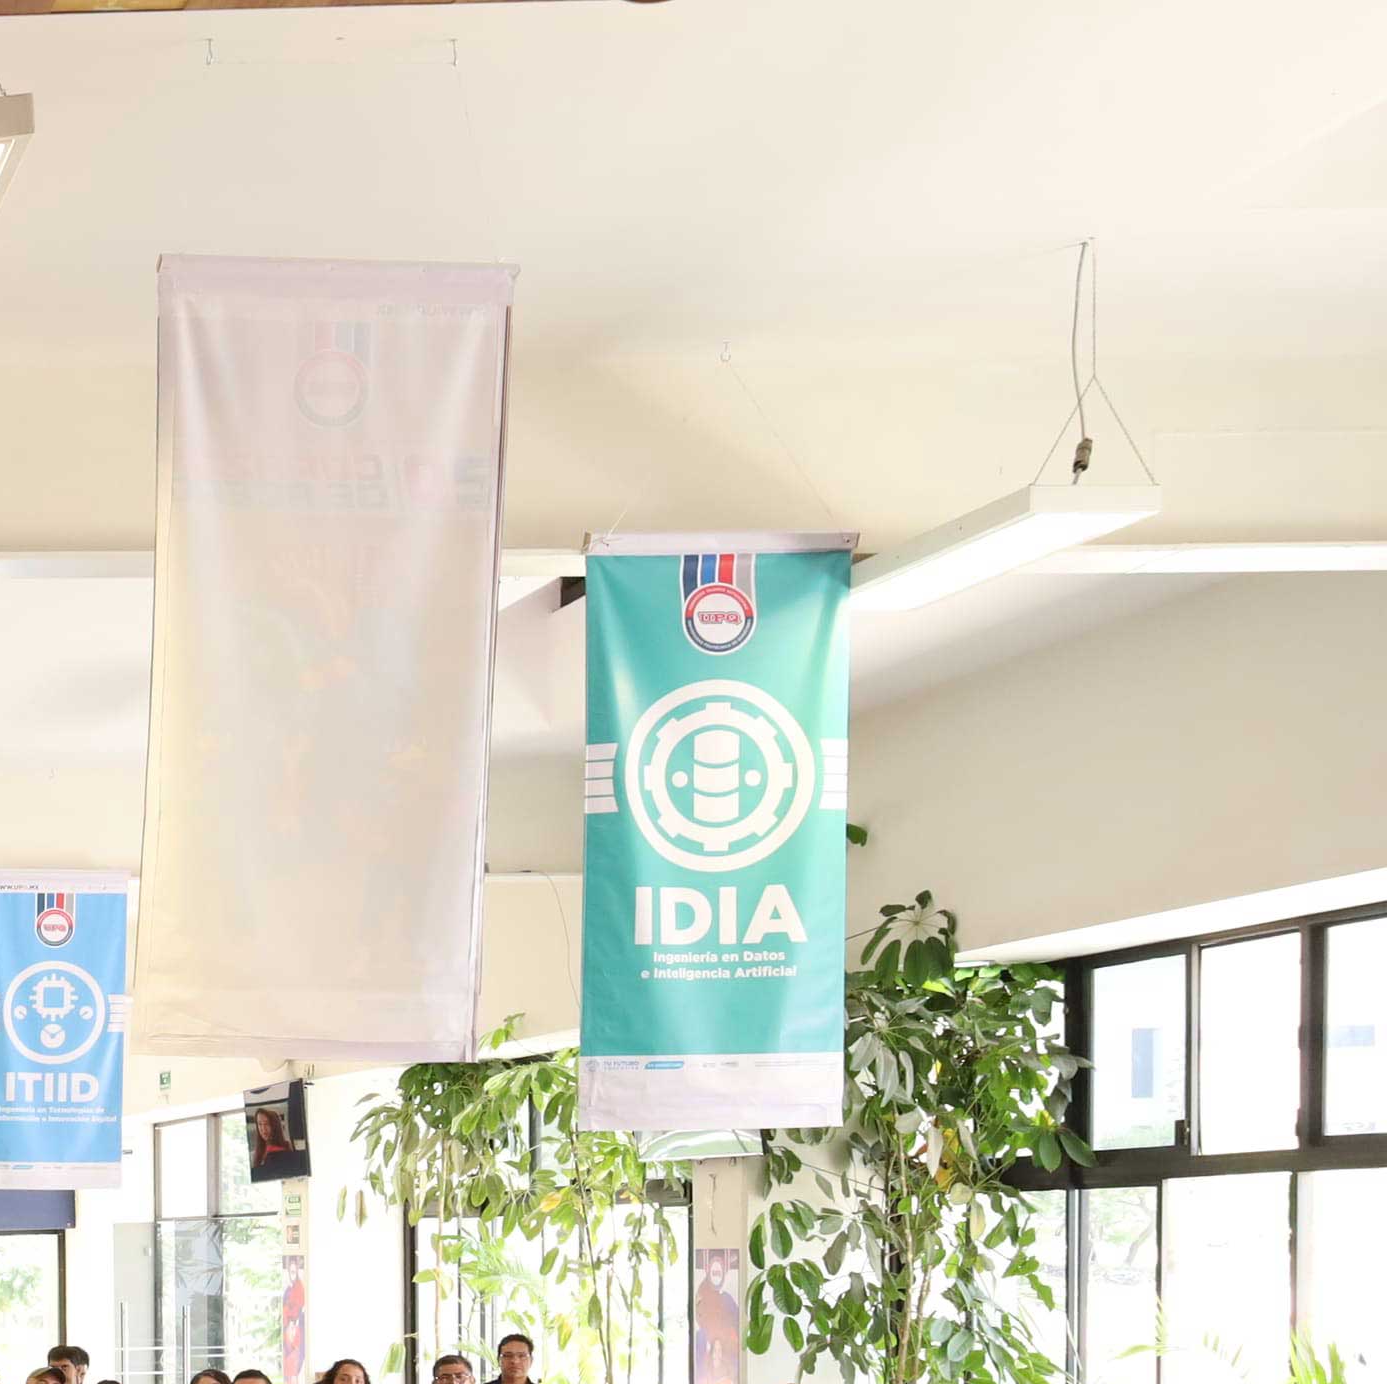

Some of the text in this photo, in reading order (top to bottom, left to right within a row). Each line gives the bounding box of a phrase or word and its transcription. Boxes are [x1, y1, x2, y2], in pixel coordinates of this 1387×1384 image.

[698, 611, 743, 626] UPQ
[634, 884, 809, 946] IDIA
[653, 951, 786, 966] Ingeniería en Datos
[641, 965, 799, 981] e Inteligencia Artificial
[5, 1072, 100, 1103] ITIID
